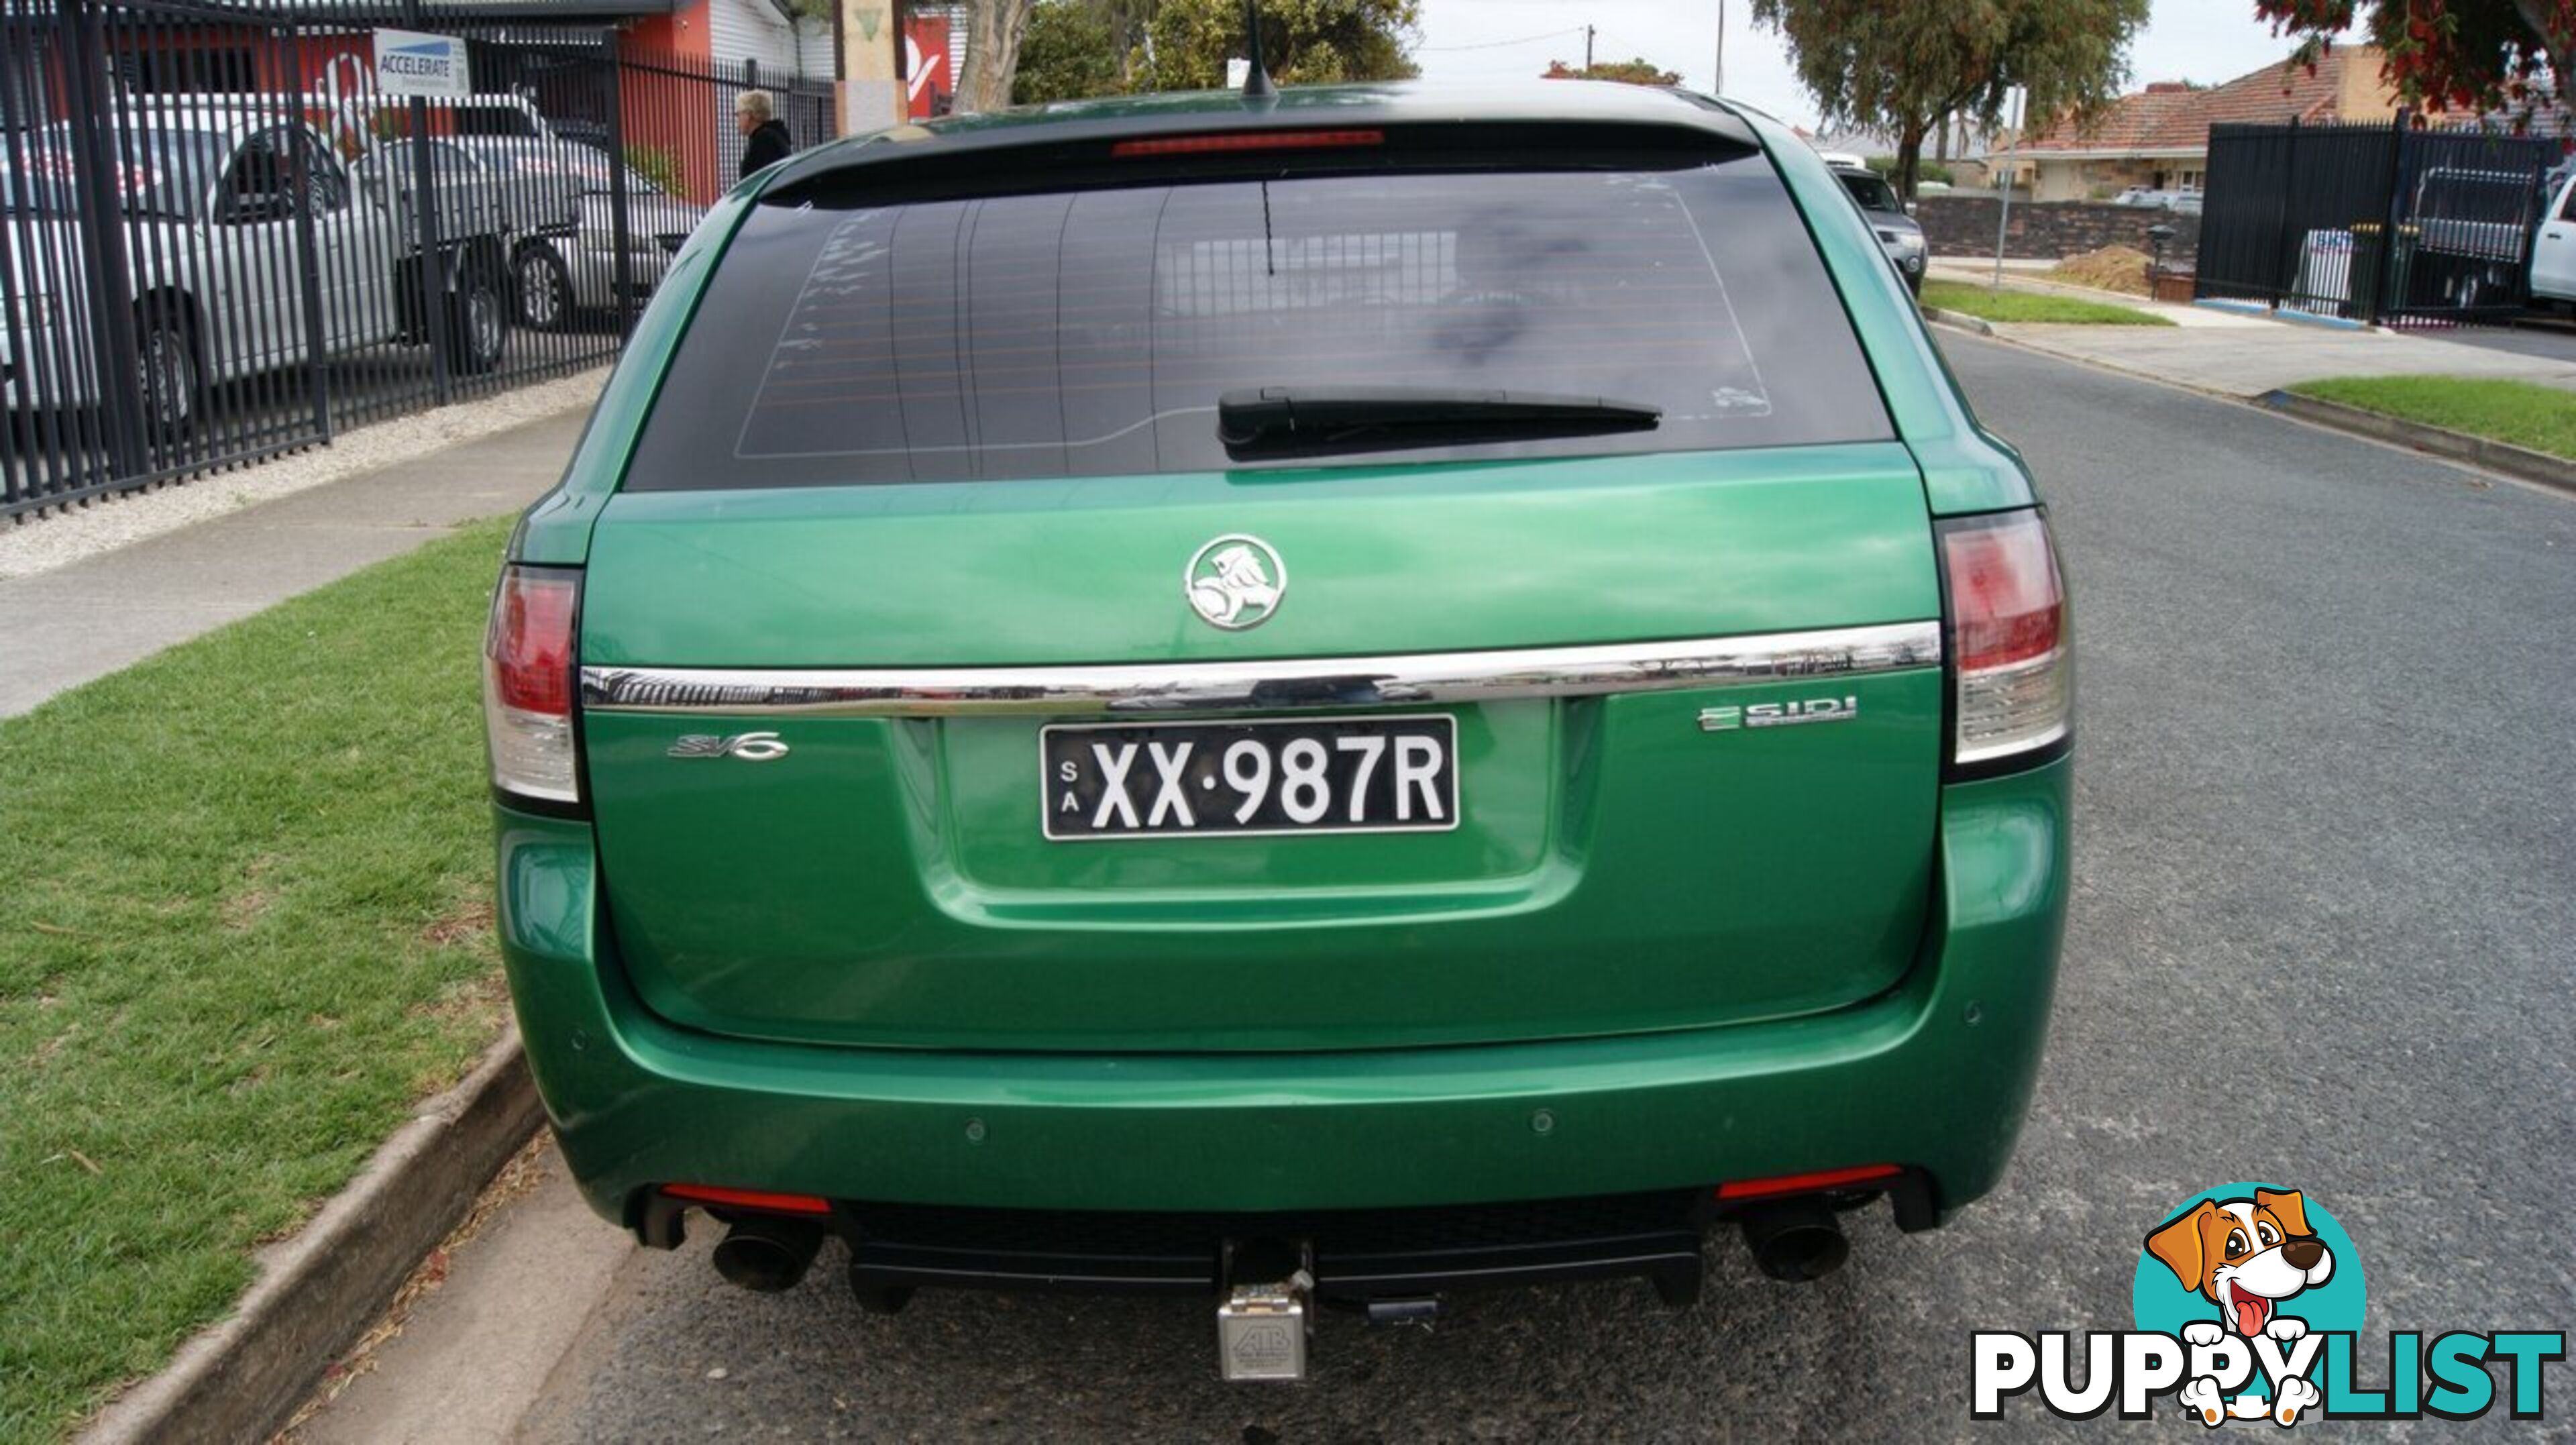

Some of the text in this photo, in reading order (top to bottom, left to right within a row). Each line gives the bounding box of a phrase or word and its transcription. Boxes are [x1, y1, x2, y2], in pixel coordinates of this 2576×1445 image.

[380, 54, 449, 77] ACCELERATE
[1746, 696, 1856, 718] SIDI
[667, 731, 789, 761] SV6
